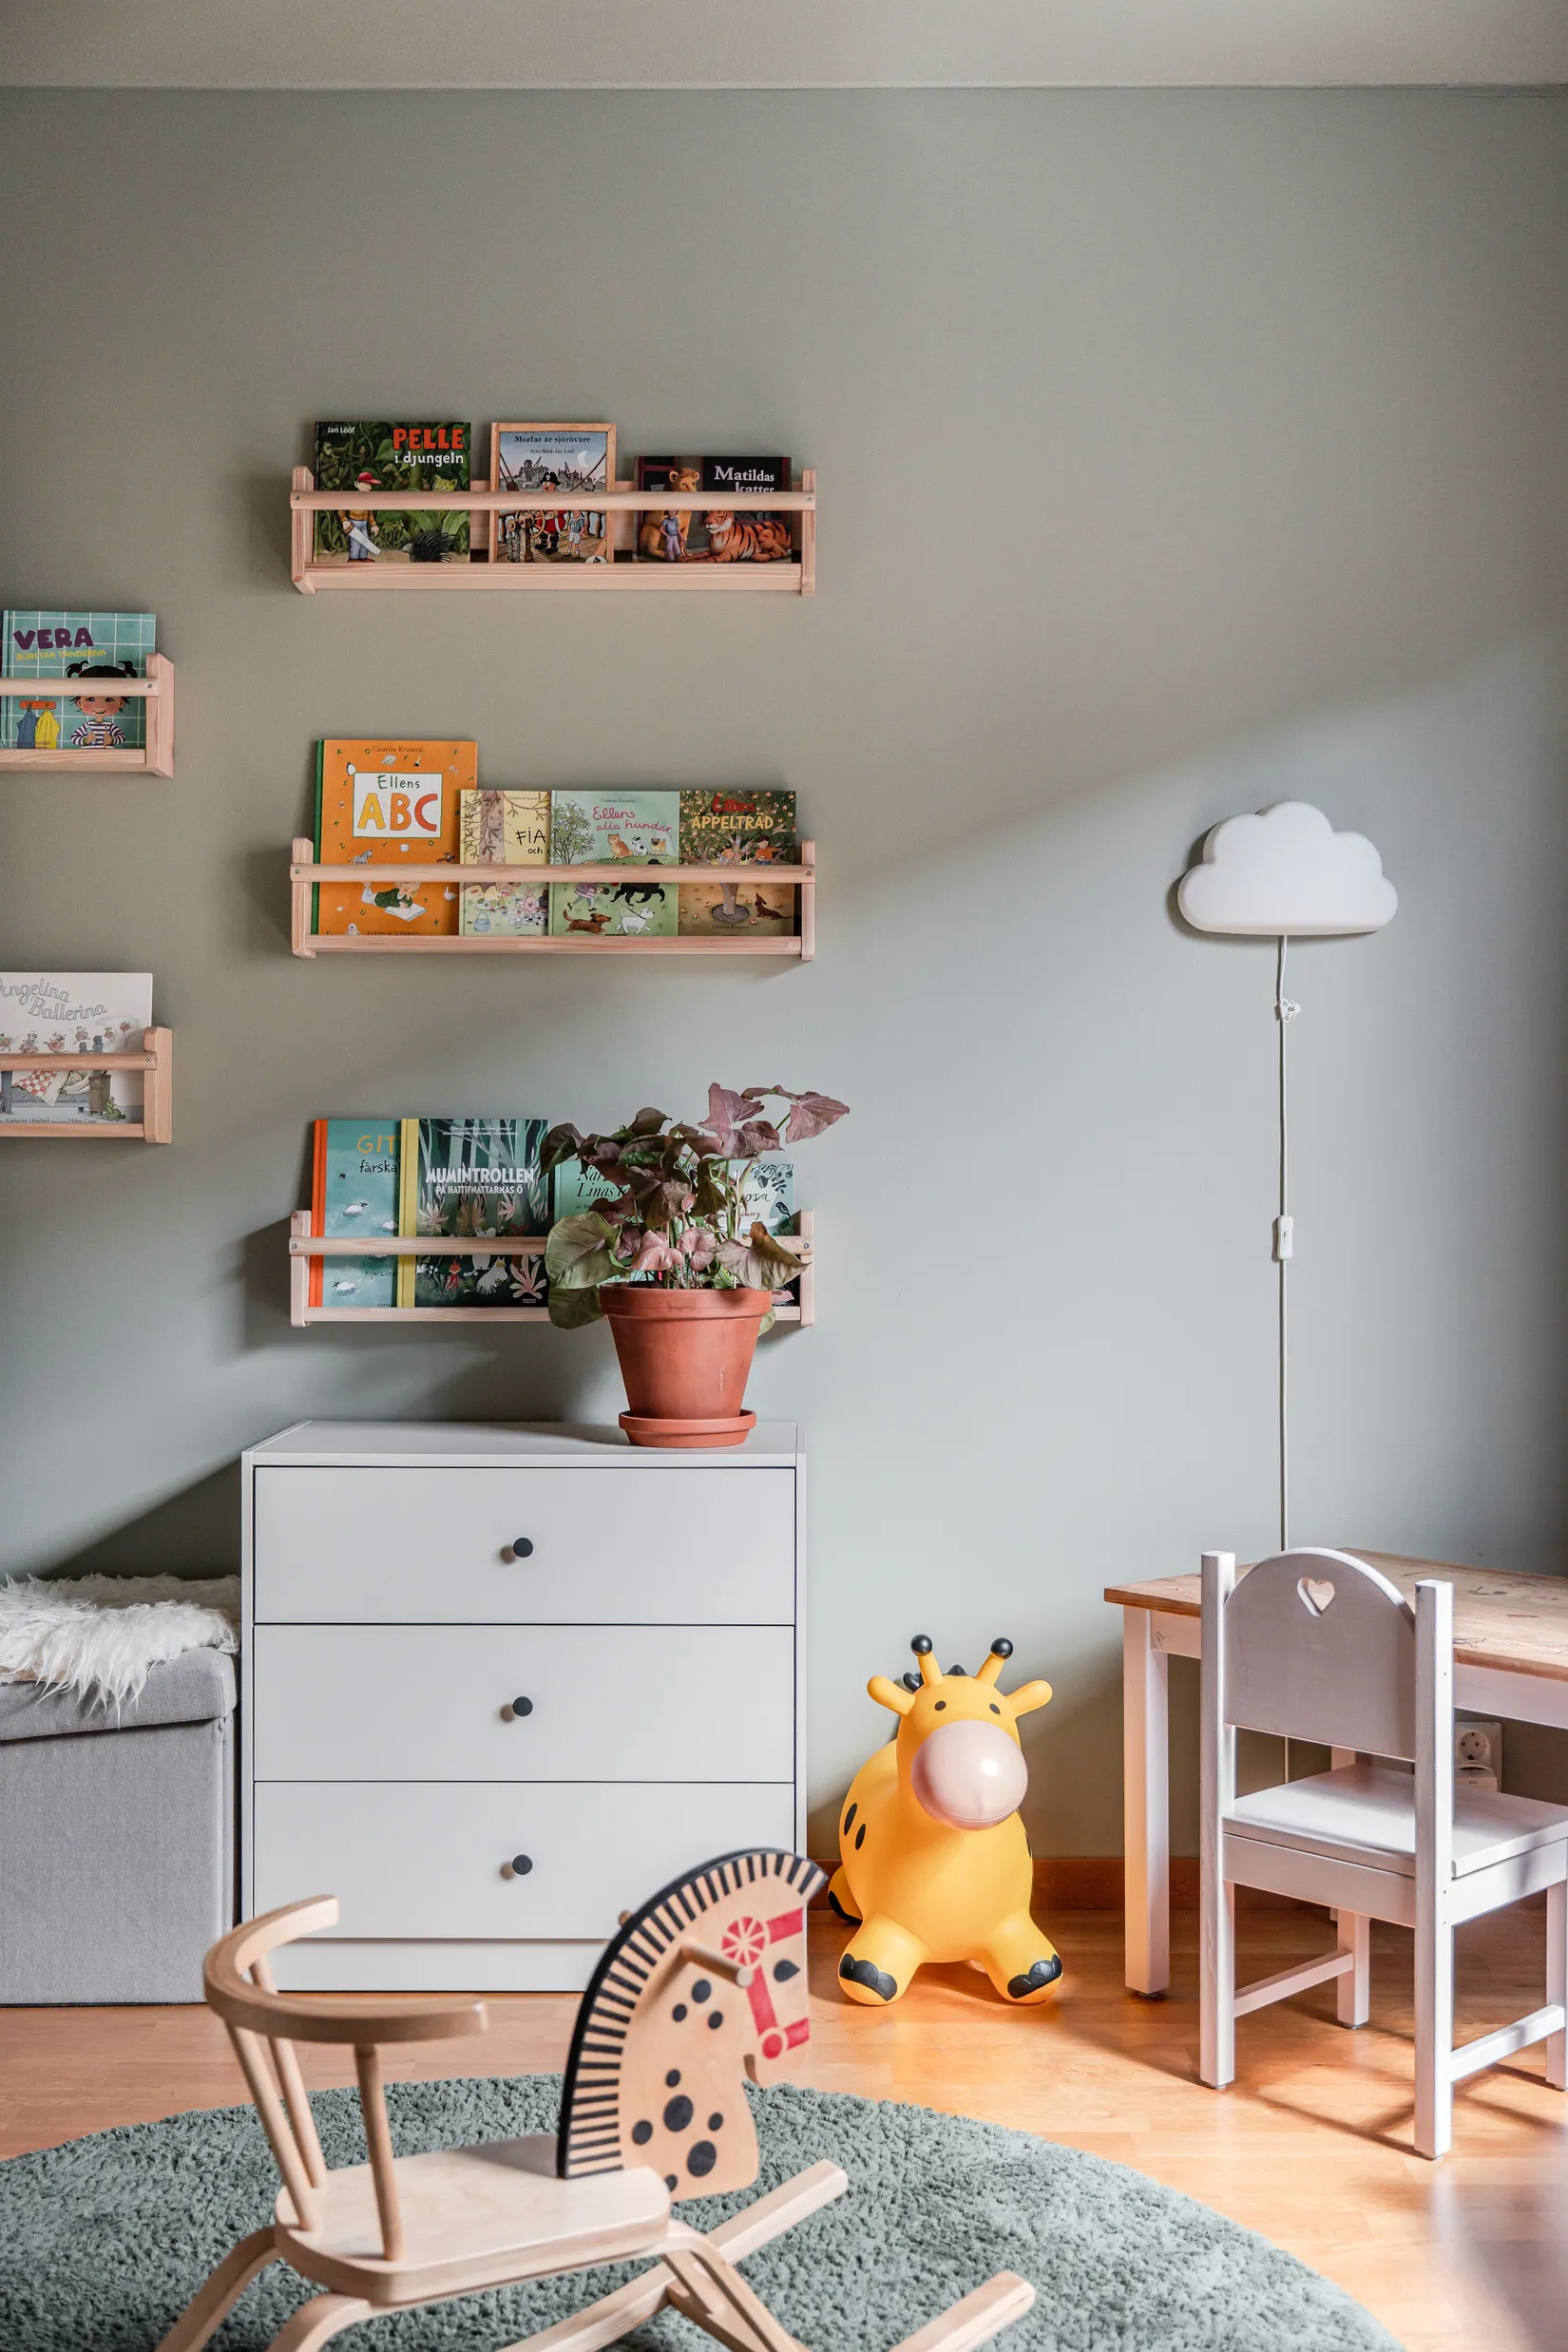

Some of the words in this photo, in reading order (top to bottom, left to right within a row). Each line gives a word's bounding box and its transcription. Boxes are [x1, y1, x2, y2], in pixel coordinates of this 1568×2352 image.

[327, 426, 339, 434] Jan
[392, 428, 465, 450] PELLE
[394, 451, 398, 464] i
[403, 451, 464, 468] djungeln
[714, 465, 774, 482] Matildas
[735, 481, 774, 492] katter
[12, 627, 94, 651] VERA
[16, 651, 56, 661] BORSTAR
[376, 774, 420, 790] Ellens
[356, 792, 439, 832] ABC
[712, 795, 755, 813] Ellens
[592, 806, 636, 820] Ellens
[691, 812, 774, 830] ÄPPELTRÄD
[596, 821, 621, 832] alla
[624, 819, 673, 832] hundar
[527, 846, 544, 854] och
[27, 996, 108, 1022] Ballerina
[356, 1135, 400, 1155] GIT
[425, 1167, 534, 1183] MUMINTROLLEN
[448, 1185, 515, 1195] HATTIFNATTARNAS
[516, 1183, 524, 1195] Ö
[577, 1183, 615, 1197] Linas
